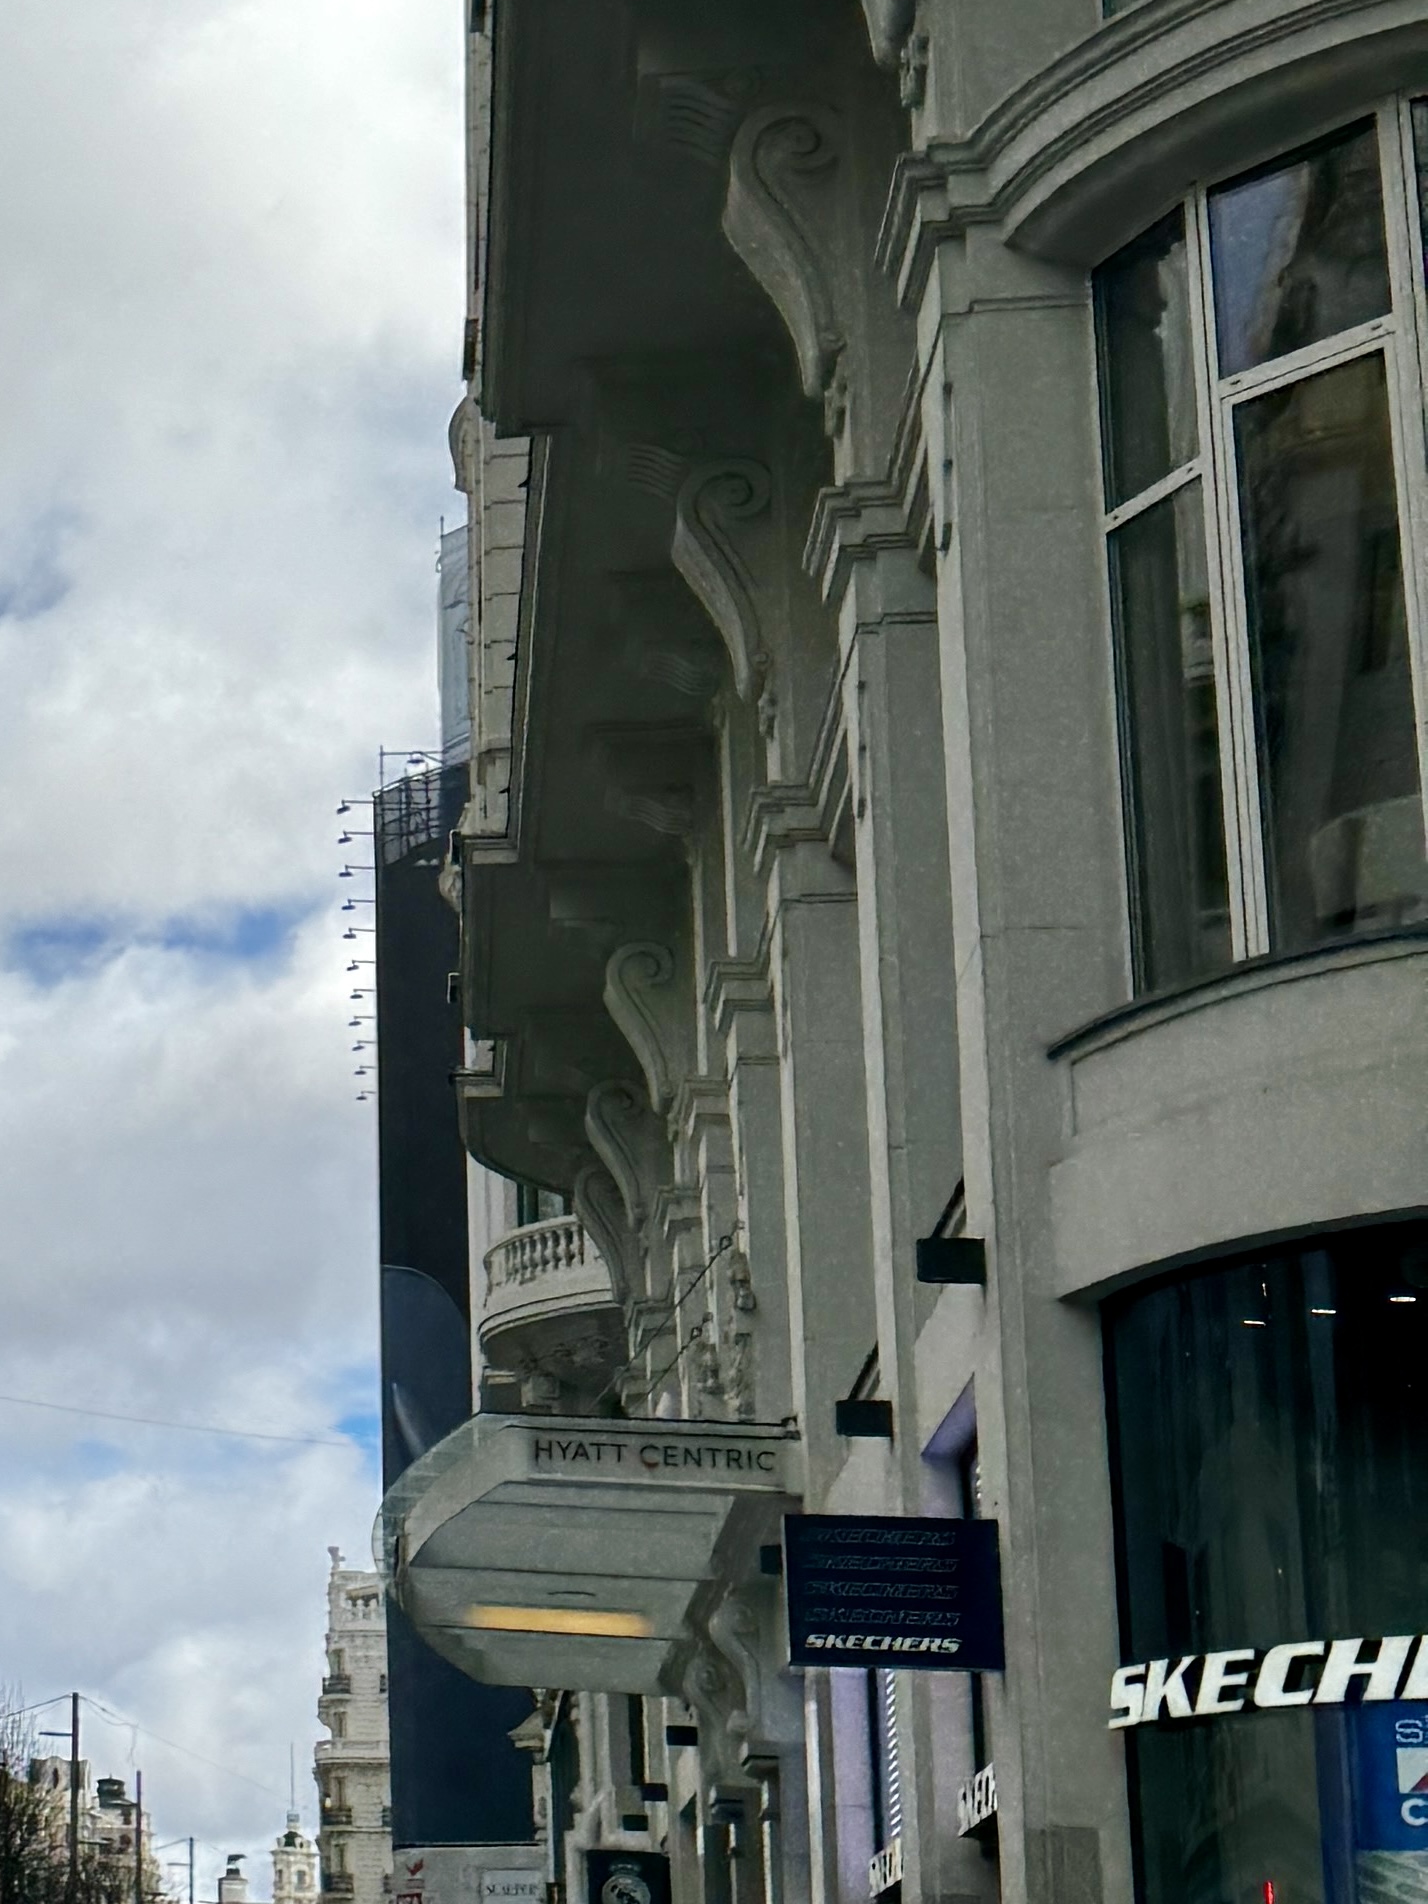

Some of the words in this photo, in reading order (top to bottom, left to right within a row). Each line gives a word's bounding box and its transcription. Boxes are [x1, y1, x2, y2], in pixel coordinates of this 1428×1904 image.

[533, 1439, 628, 1464] HYATT
[639, 1443, 777, 1472] CENTRIC
[804, 1633, 963, 1654] SKECHERS
